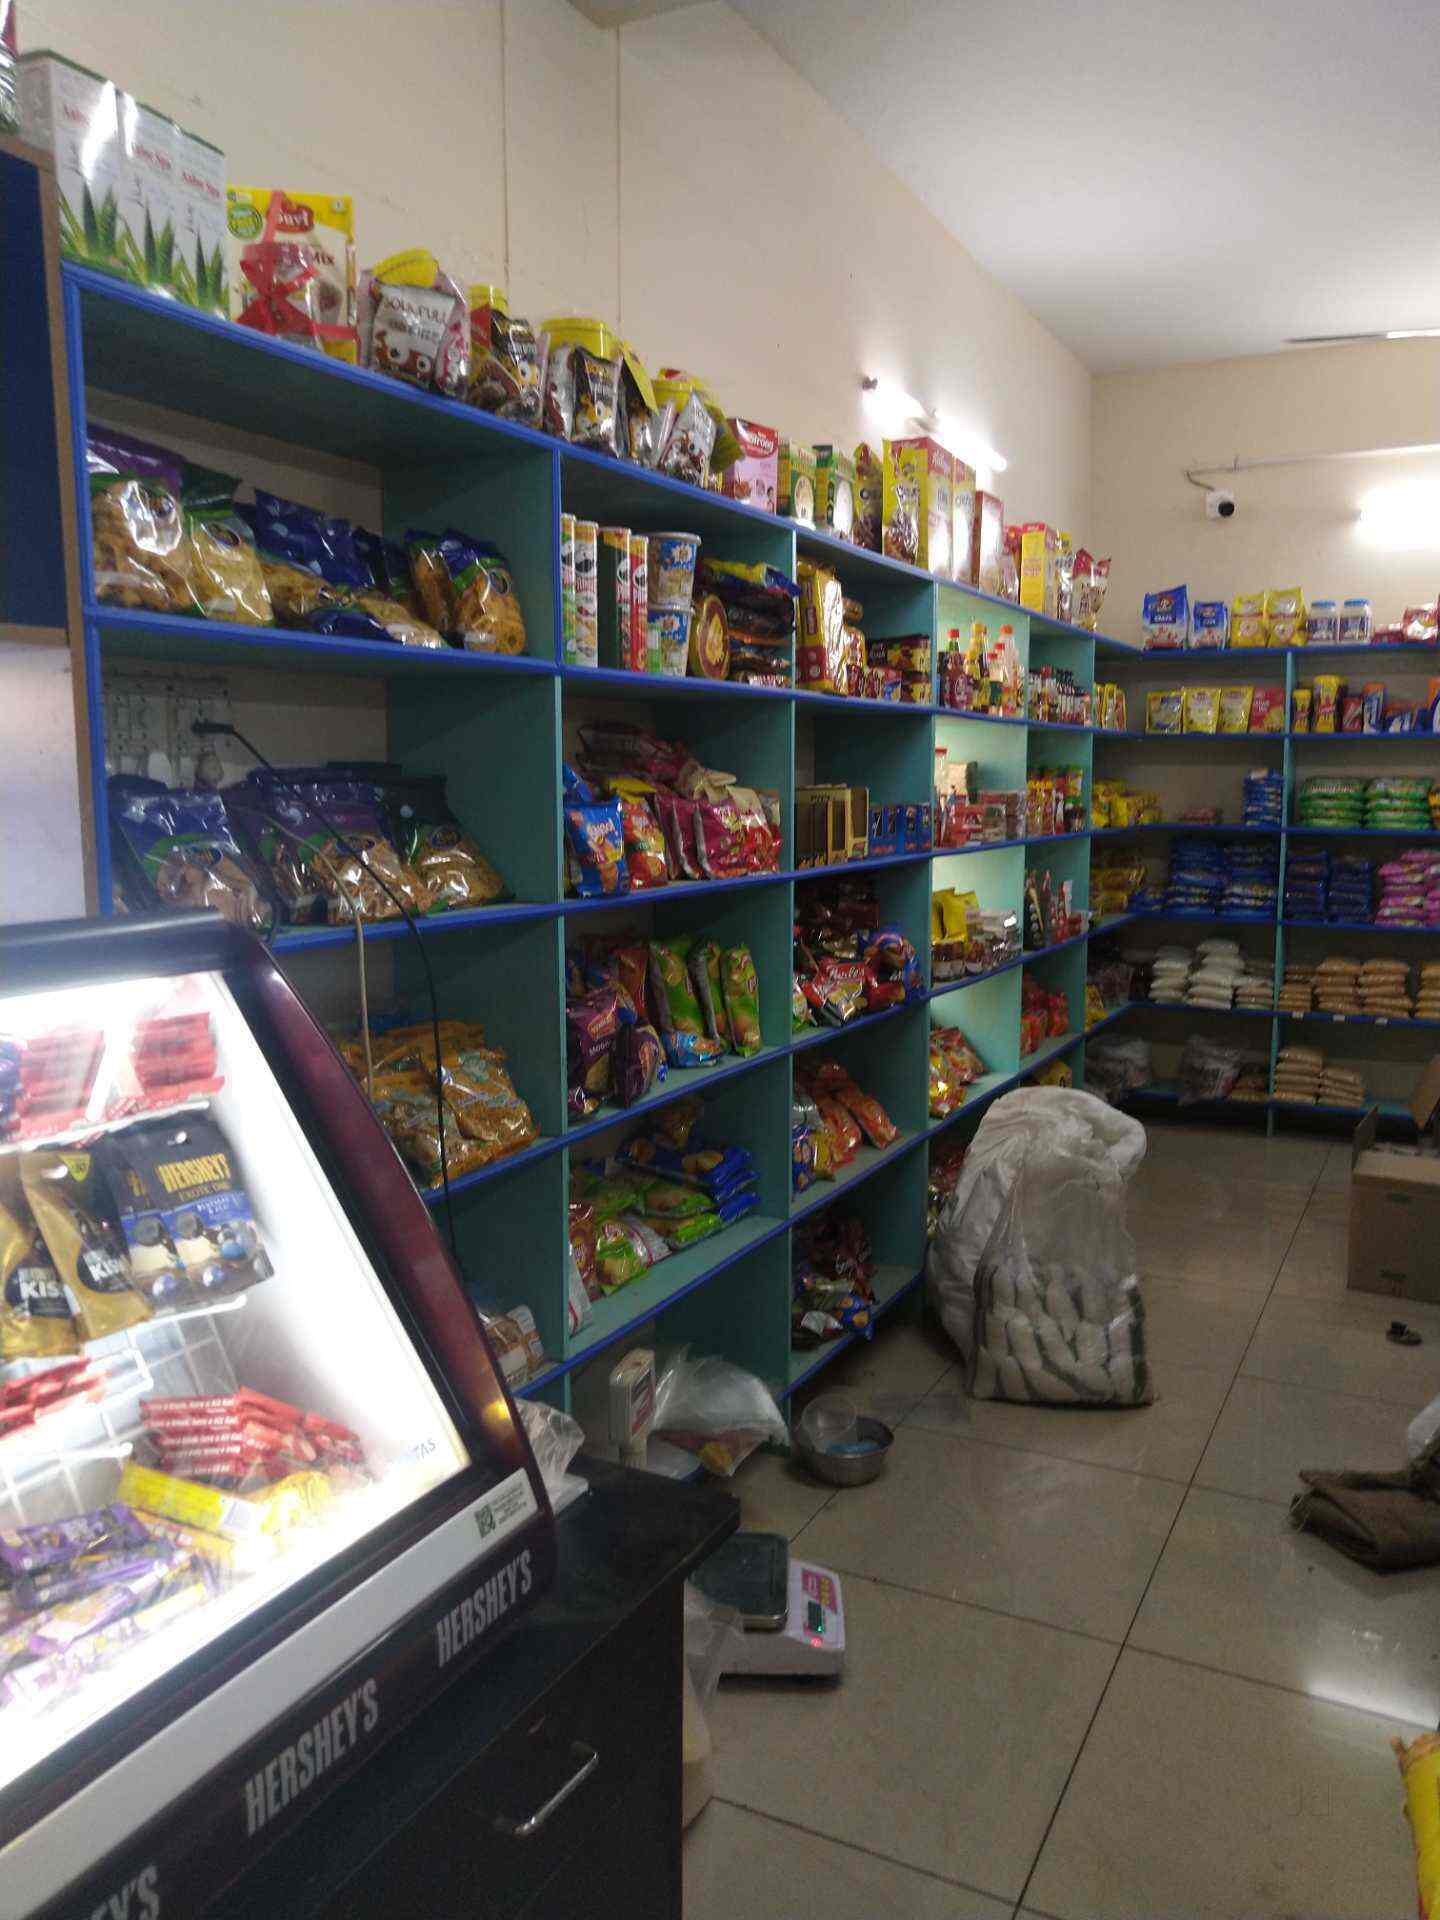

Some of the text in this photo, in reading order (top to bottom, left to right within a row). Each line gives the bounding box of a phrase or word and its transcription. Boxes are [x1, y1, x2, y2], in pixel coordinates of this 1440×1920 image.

[155, 1153, 231, 1193] HERSHEY'S
[436, 1549, 533, 1668] HERSHEY'S
[244, 1677, 379, 1837] HERSHEY'S
